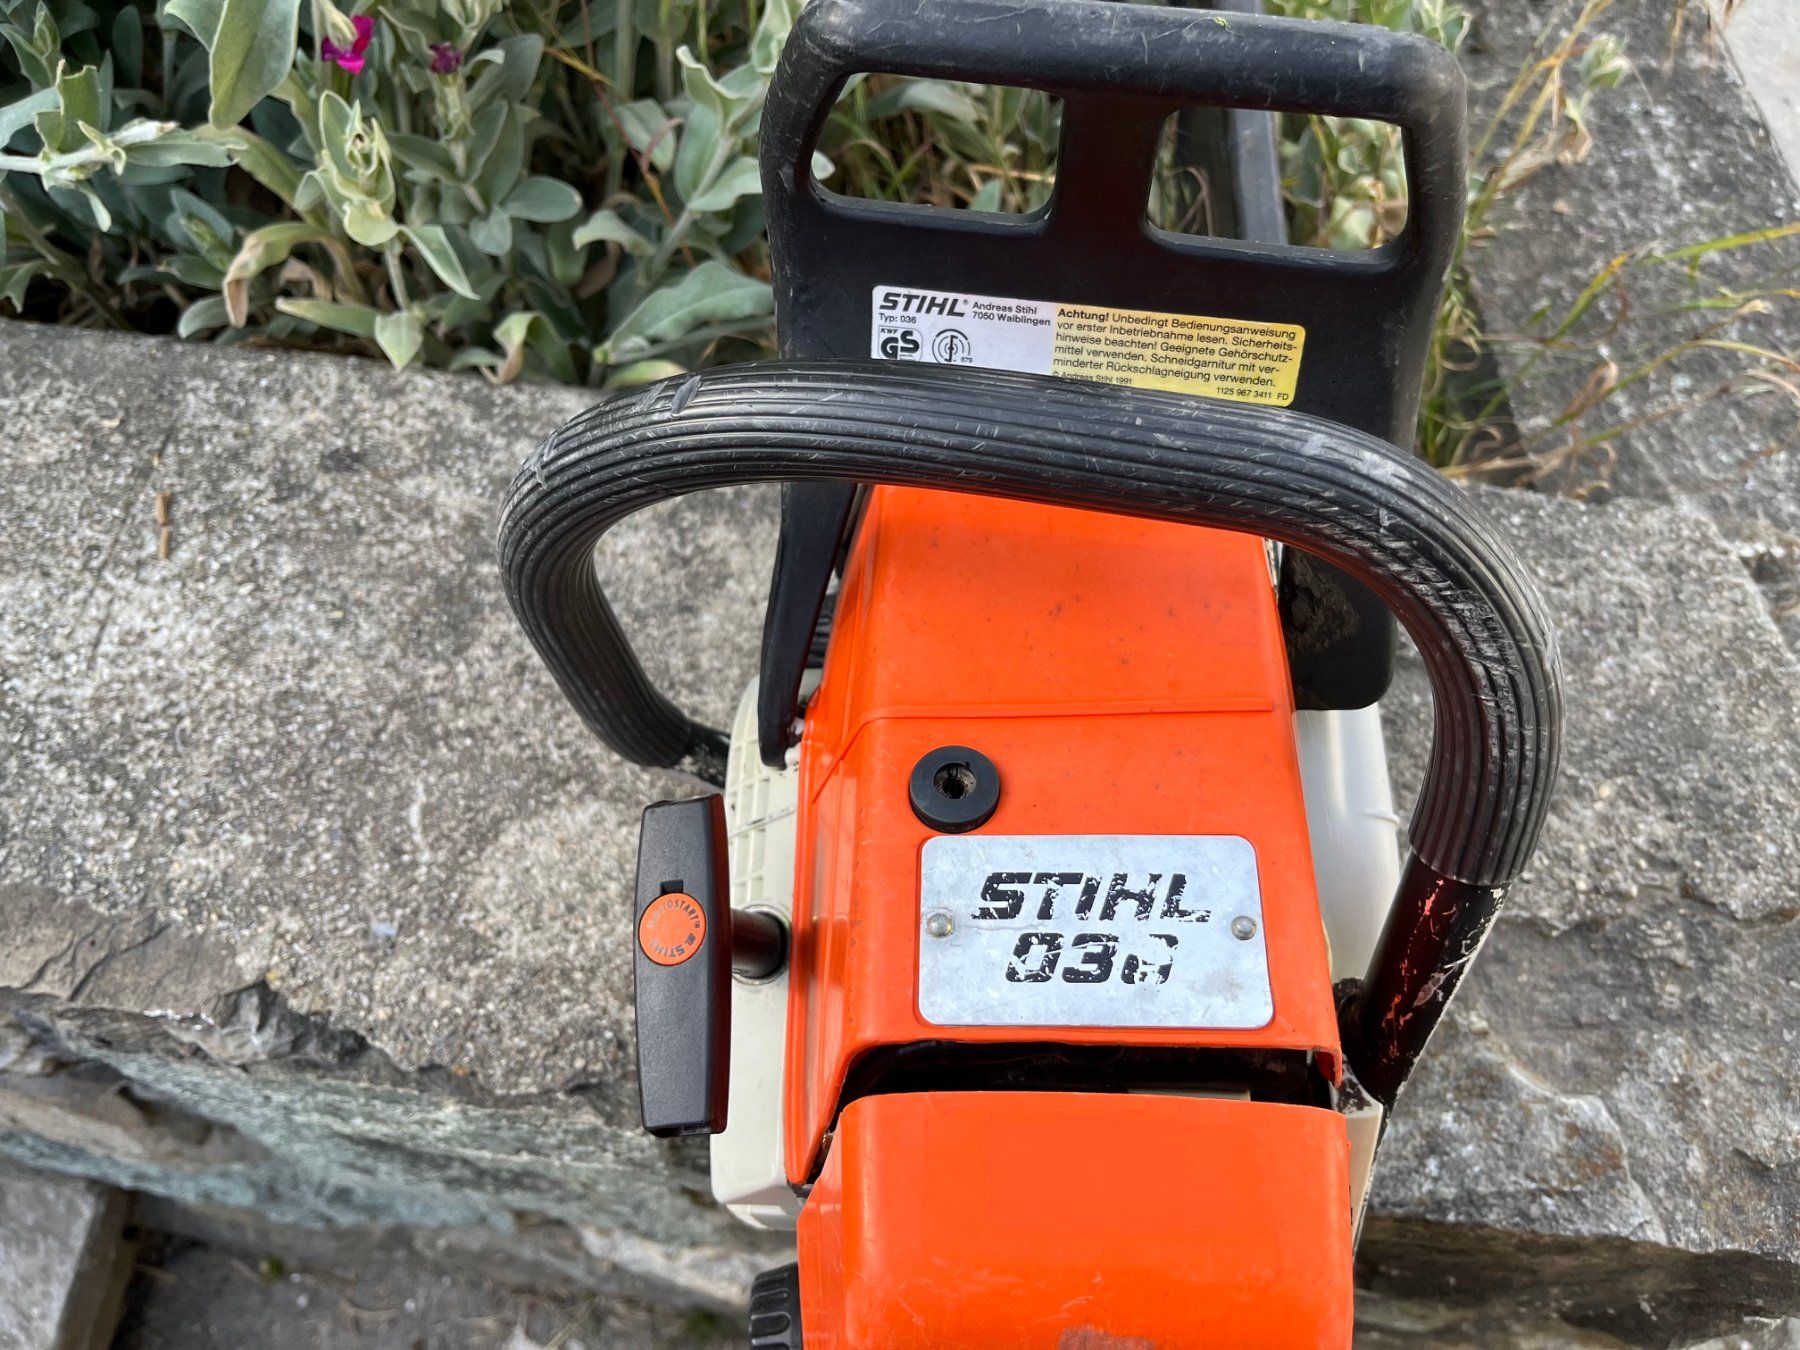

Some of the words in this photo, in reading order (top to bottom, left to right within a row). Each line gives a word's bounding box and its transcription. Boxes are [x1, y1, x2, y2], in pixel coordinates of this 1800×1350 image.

[878, 313, 898, 322] Typ:
[900, 315, 917, 323] 036
[879, 292, 965, 317] STIHL
[972, 302, 1012, 312] Andreas
[1015, 305, 1037, 315] Stihl
[972, 311, 995, 321] 7050
[997, 313, 1051, 326] Waiblingen
[1058, 308, 1109, 323] Achtung!
[1112, 313, 1168, 329] Unbedingt
[1171, 319, 1296, 341] Bedienungsanweisung
[1055, 332, 1102, 345] hinweise
[1104, 337, 1157, 350] beachten!
[1160, 342, 1215, 355] Geeignete
[1218, 347, 1293, 363] Gehörschutz-
[1057, 322, 1074, 331] vor
[1076, 323, 1107, 333] erster
[1110, 326, 1194, 342] Inbetriebnahme
[1196, 333, 1228, 345] lesen.
[1231, 336, 1297, 351] Sicherheits-
[1053, 357, 1104, 370] minderter
[1106, 361, 1211, 382] Rückschlagneigung
[1213, 373, 1276, 387] verwenden.
[1055, 345, 1083, 355] mittel
[1086, 349, 1147, 361] verwenden.
[1150, 353, 1238, 369] Schneidgarnitur
[1238, 363, 1256, 372] mit
[1258, 366, 1280, 374] ver-
[1062, 371, 1094, 381] Andreas
[1115, 377, 1132, 385] 1991
[1216, 387, 1234, 395] 1125
[1236, 389, 1252, 397] 967
[1253, 390, 1272, 399] 3411
[971, 871, 1211, 922] STIHL
